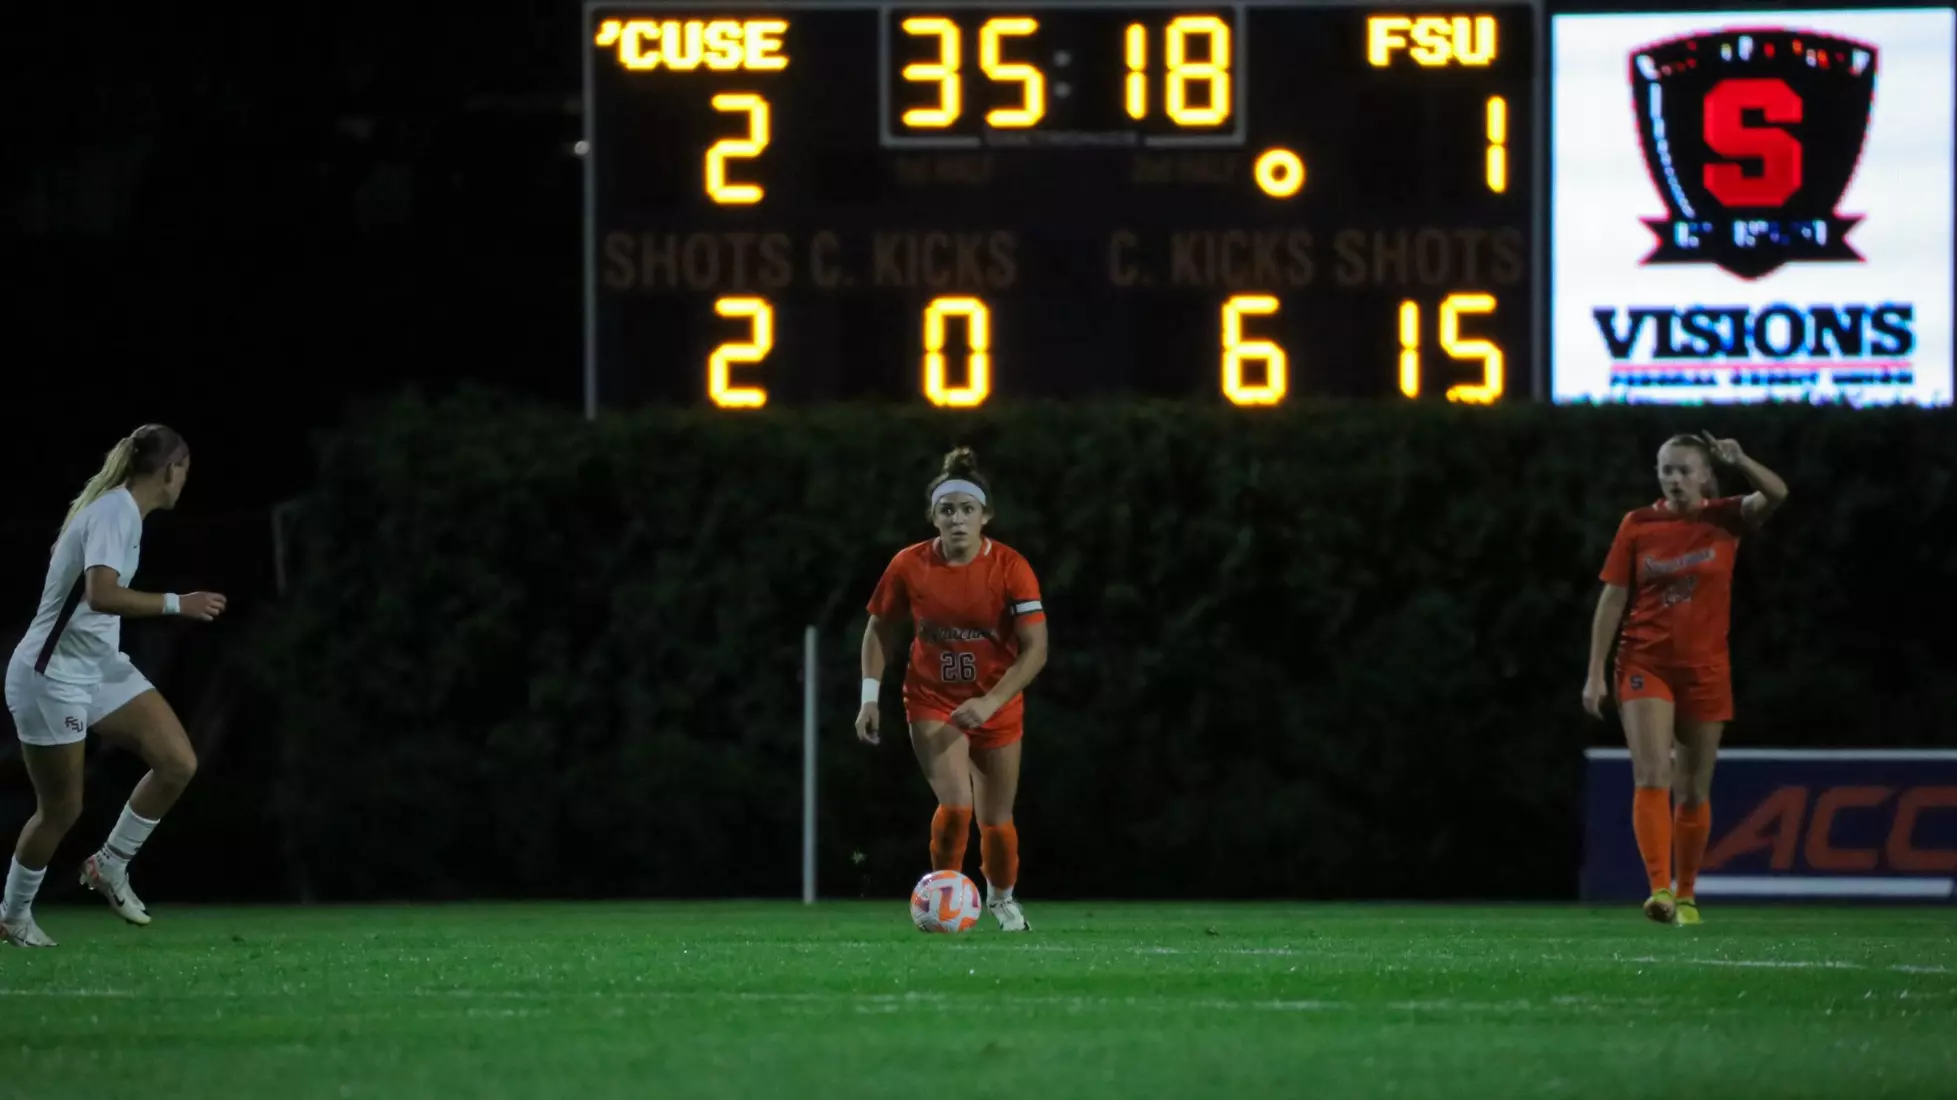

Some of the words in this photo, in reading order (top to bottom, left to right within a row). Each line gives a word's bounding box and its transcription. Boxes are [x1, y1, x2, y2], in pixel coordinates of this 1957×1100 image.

[1368, 16, 1497, 66] FSU
[705, 94, 769, 204] 2
[1486, 96, 1506, 192] 1
[1702, 78, 1804, 207] S
[603, 233, 794, 288] SHOTS
[811, 232, 855, 288] C.
[873, 232, 1018, 288] KICKS
[1110, 231, 1158, 287] C.
[1170, 230, 1315, 286] KICKS
[1333, 228, 1525, 285] SHOTS
[708, 297, 773, 408] 2
[924, 297, 990, 407] 0
[1222, 295, 1287, 406] 6
[1399, 294, 1503, 404] 15
[1593, 303, 1914, 358] VISIONS
[941, 652, 976, 682] 26
[64, 716, 84, 733] FSU
[1704, 786, 1957, 872] ACC
